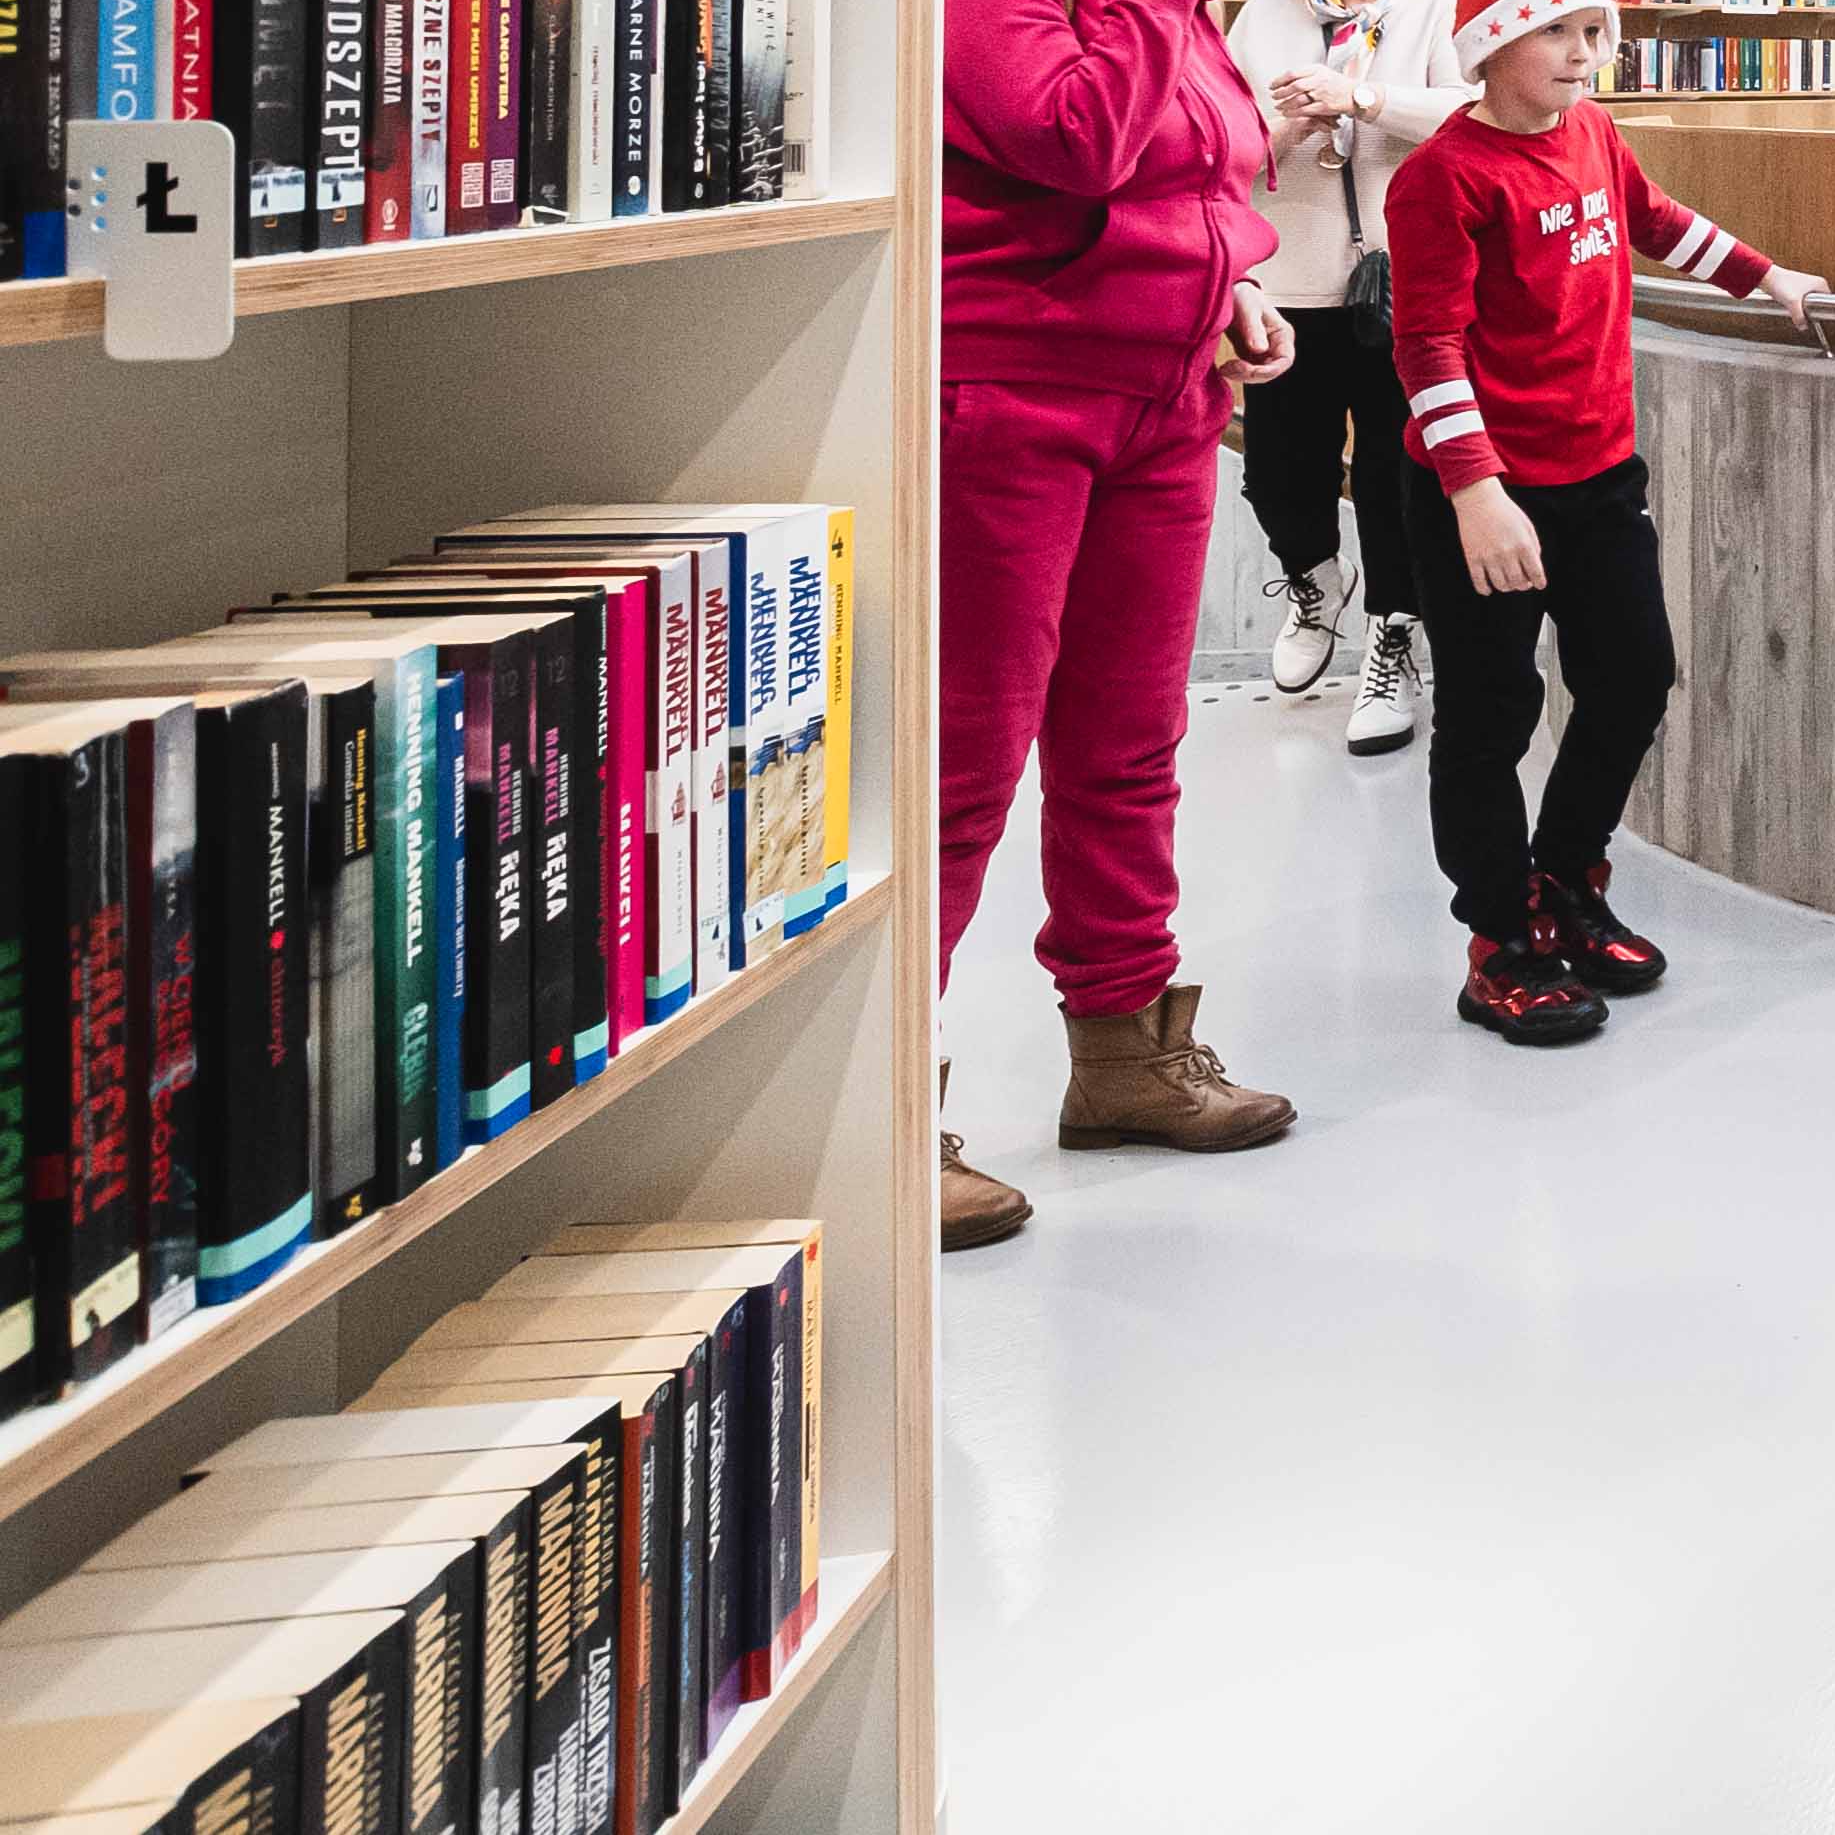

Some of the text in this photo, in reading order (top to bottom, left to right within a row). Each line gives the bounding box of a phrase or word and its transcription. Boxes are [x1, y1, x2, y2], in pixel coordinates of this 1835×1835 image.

[381, 2, 404, 105] MAŁGORZATA
[420, 58, 443, 144] SZEPTY
[468, 26, 481, 72] MUSI
[497, 12, 512, 120] GANGSTERA
[626, 72, 643, 163] MORZE
[136, 162, 198, 234] Ł
[1539, 202, 1575, 235] Nie
[665, 602, 685, 767] MANKELL
[704, 586, 724, 748] MANKELL
[760, 586, 778, 704] HENNING
[787, 556, 810, 707] MANKELL
[805, 570, 823, 686] HENNING
[833, 583, 845, 707] HENNING MANKELL
[404, 672, 423, 968] HENNING MANKELL
[452, 754, 465, 839] MANKELL
[497, 742, 513, 845] MANKELL
[544, 727, 560, 825] MANKELL
[558, 753, 570, 818] HENNING
[266, 804, 285, 927] MANKELL
[494, 849, 521, 942] RĘKA
[541, 832, 569, 922] RĘKA
[620, 802, 632, 947] MANKELL
[150, 1091, 173, 1204] GÓRY
[708, 1396, 726, 1559] MARININA
[769, 1348, 782, 1505] MARININA
[602, 1453, 618, 1589] ALEKSANDRA
[482, 1530, 517, 1761] MARININA
[535, 1482, 575, 1702] MARININA
[410, 1591, 447, 1833] MARININA
[585, 1636, 612, 1743] ZASADA
